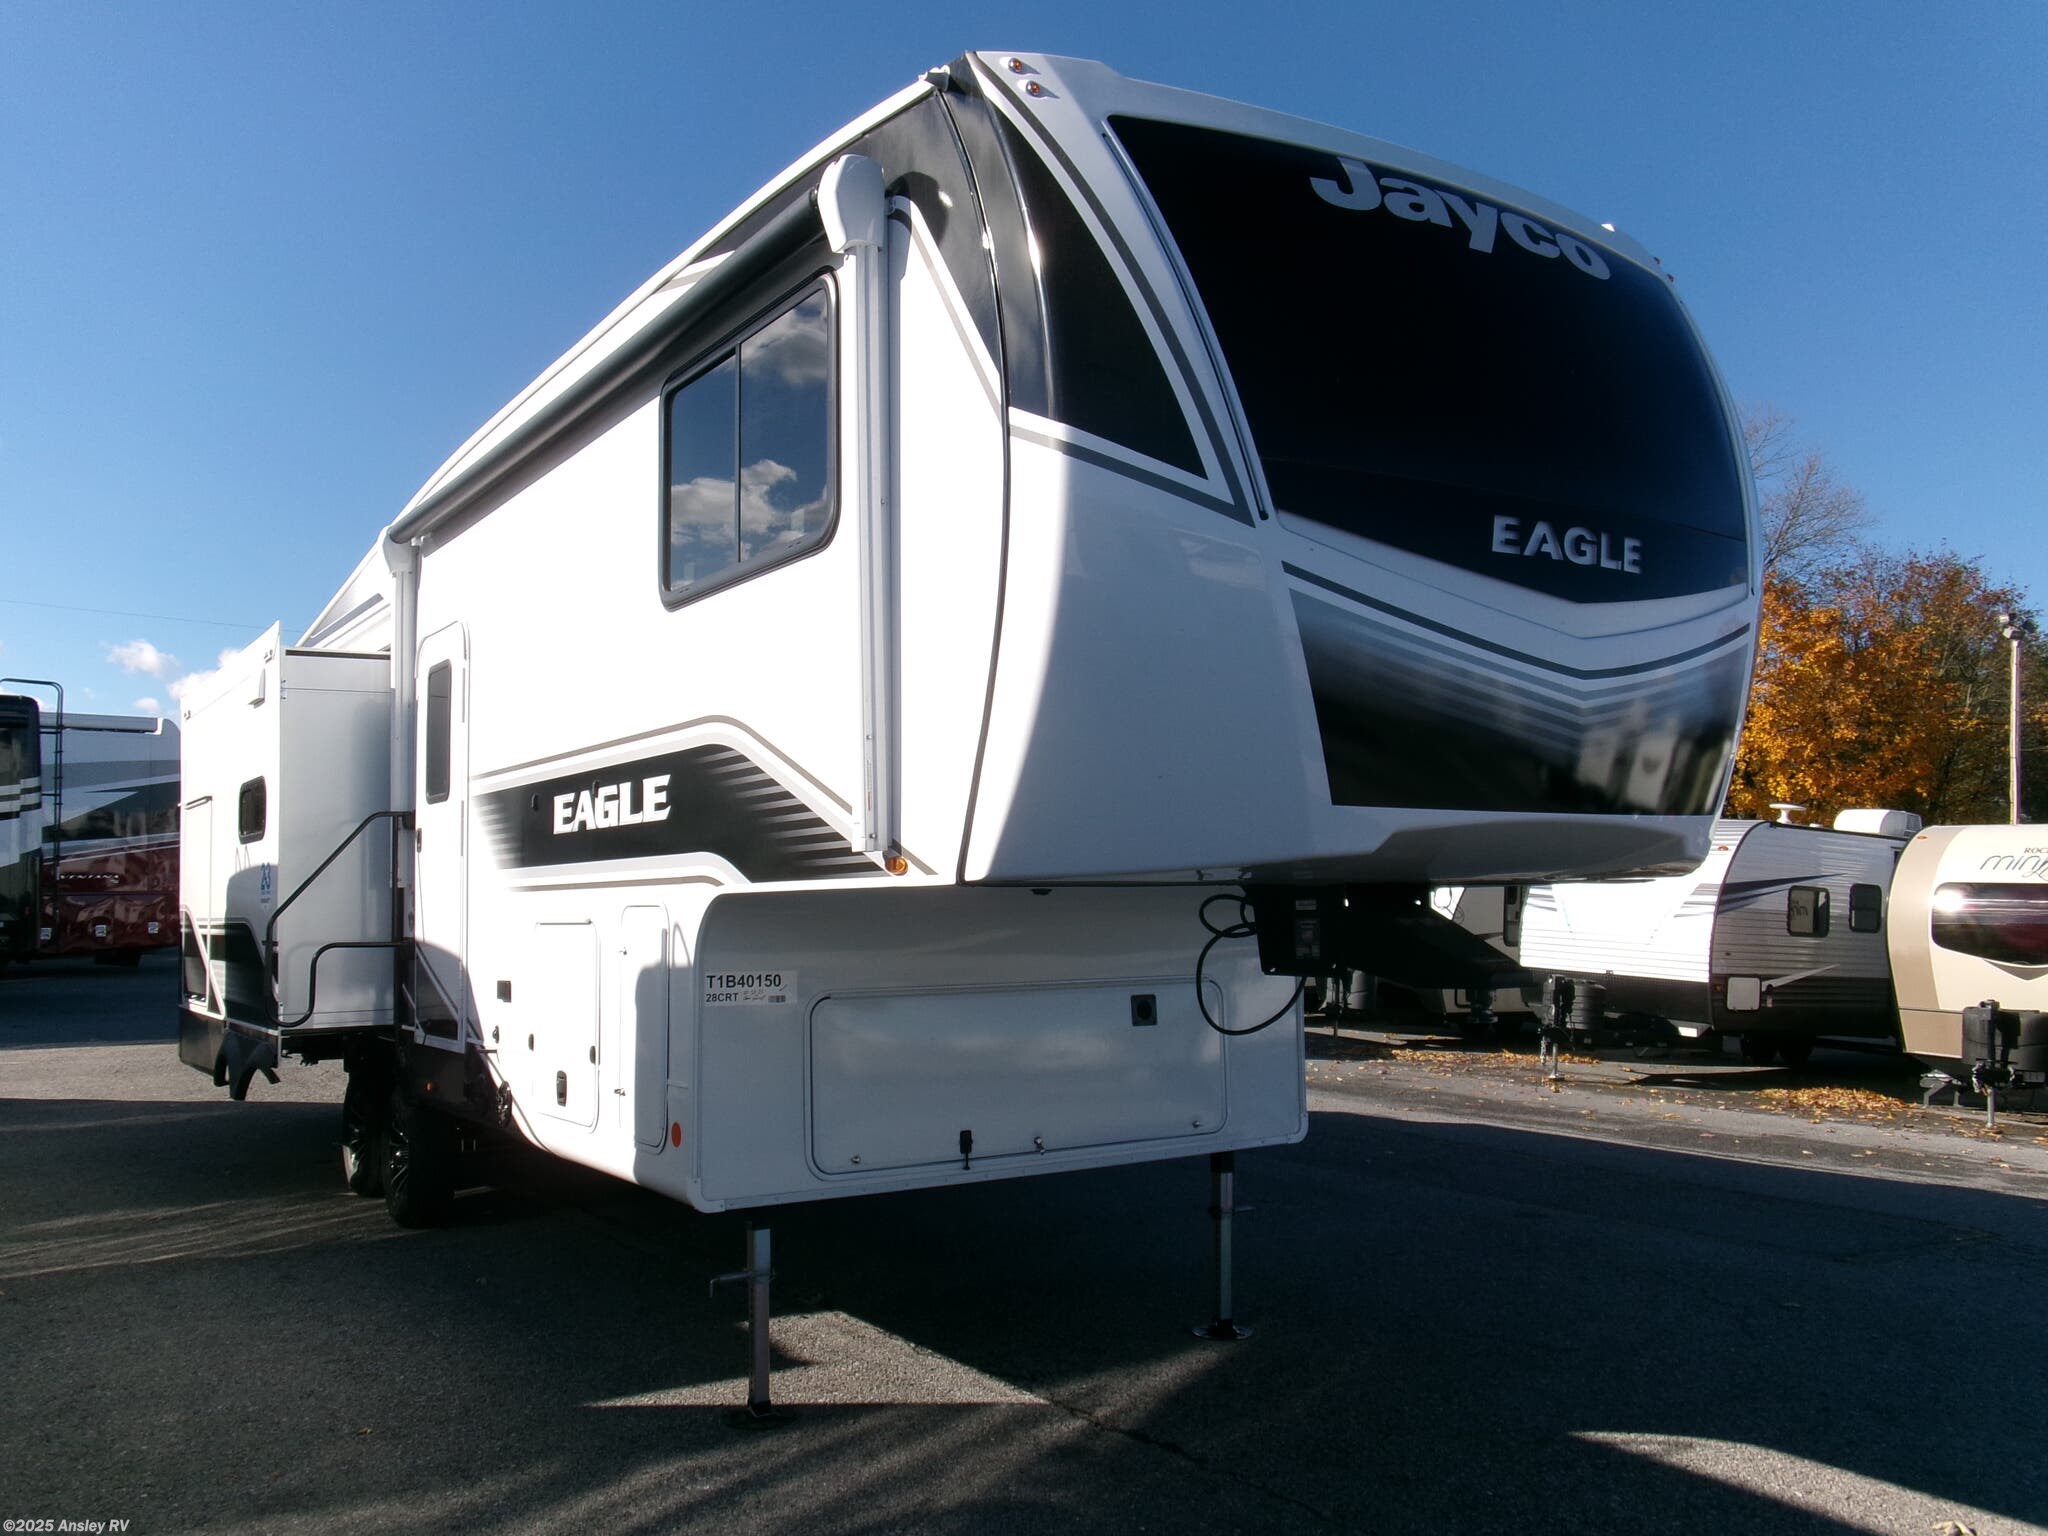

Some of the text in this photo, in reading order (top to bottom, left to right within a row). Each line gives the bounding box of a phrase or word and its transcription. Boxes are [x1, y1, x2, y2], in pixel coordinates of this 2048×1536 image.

[1309, 156, 1611, 280] Jayco
[1492, 514, 1643, 575] EAGLE
[552, 773, 672, 836] EAGLE
[705, 992, 739, 1003] 28CRT
[706, 973, 782, 989] T1B40150
